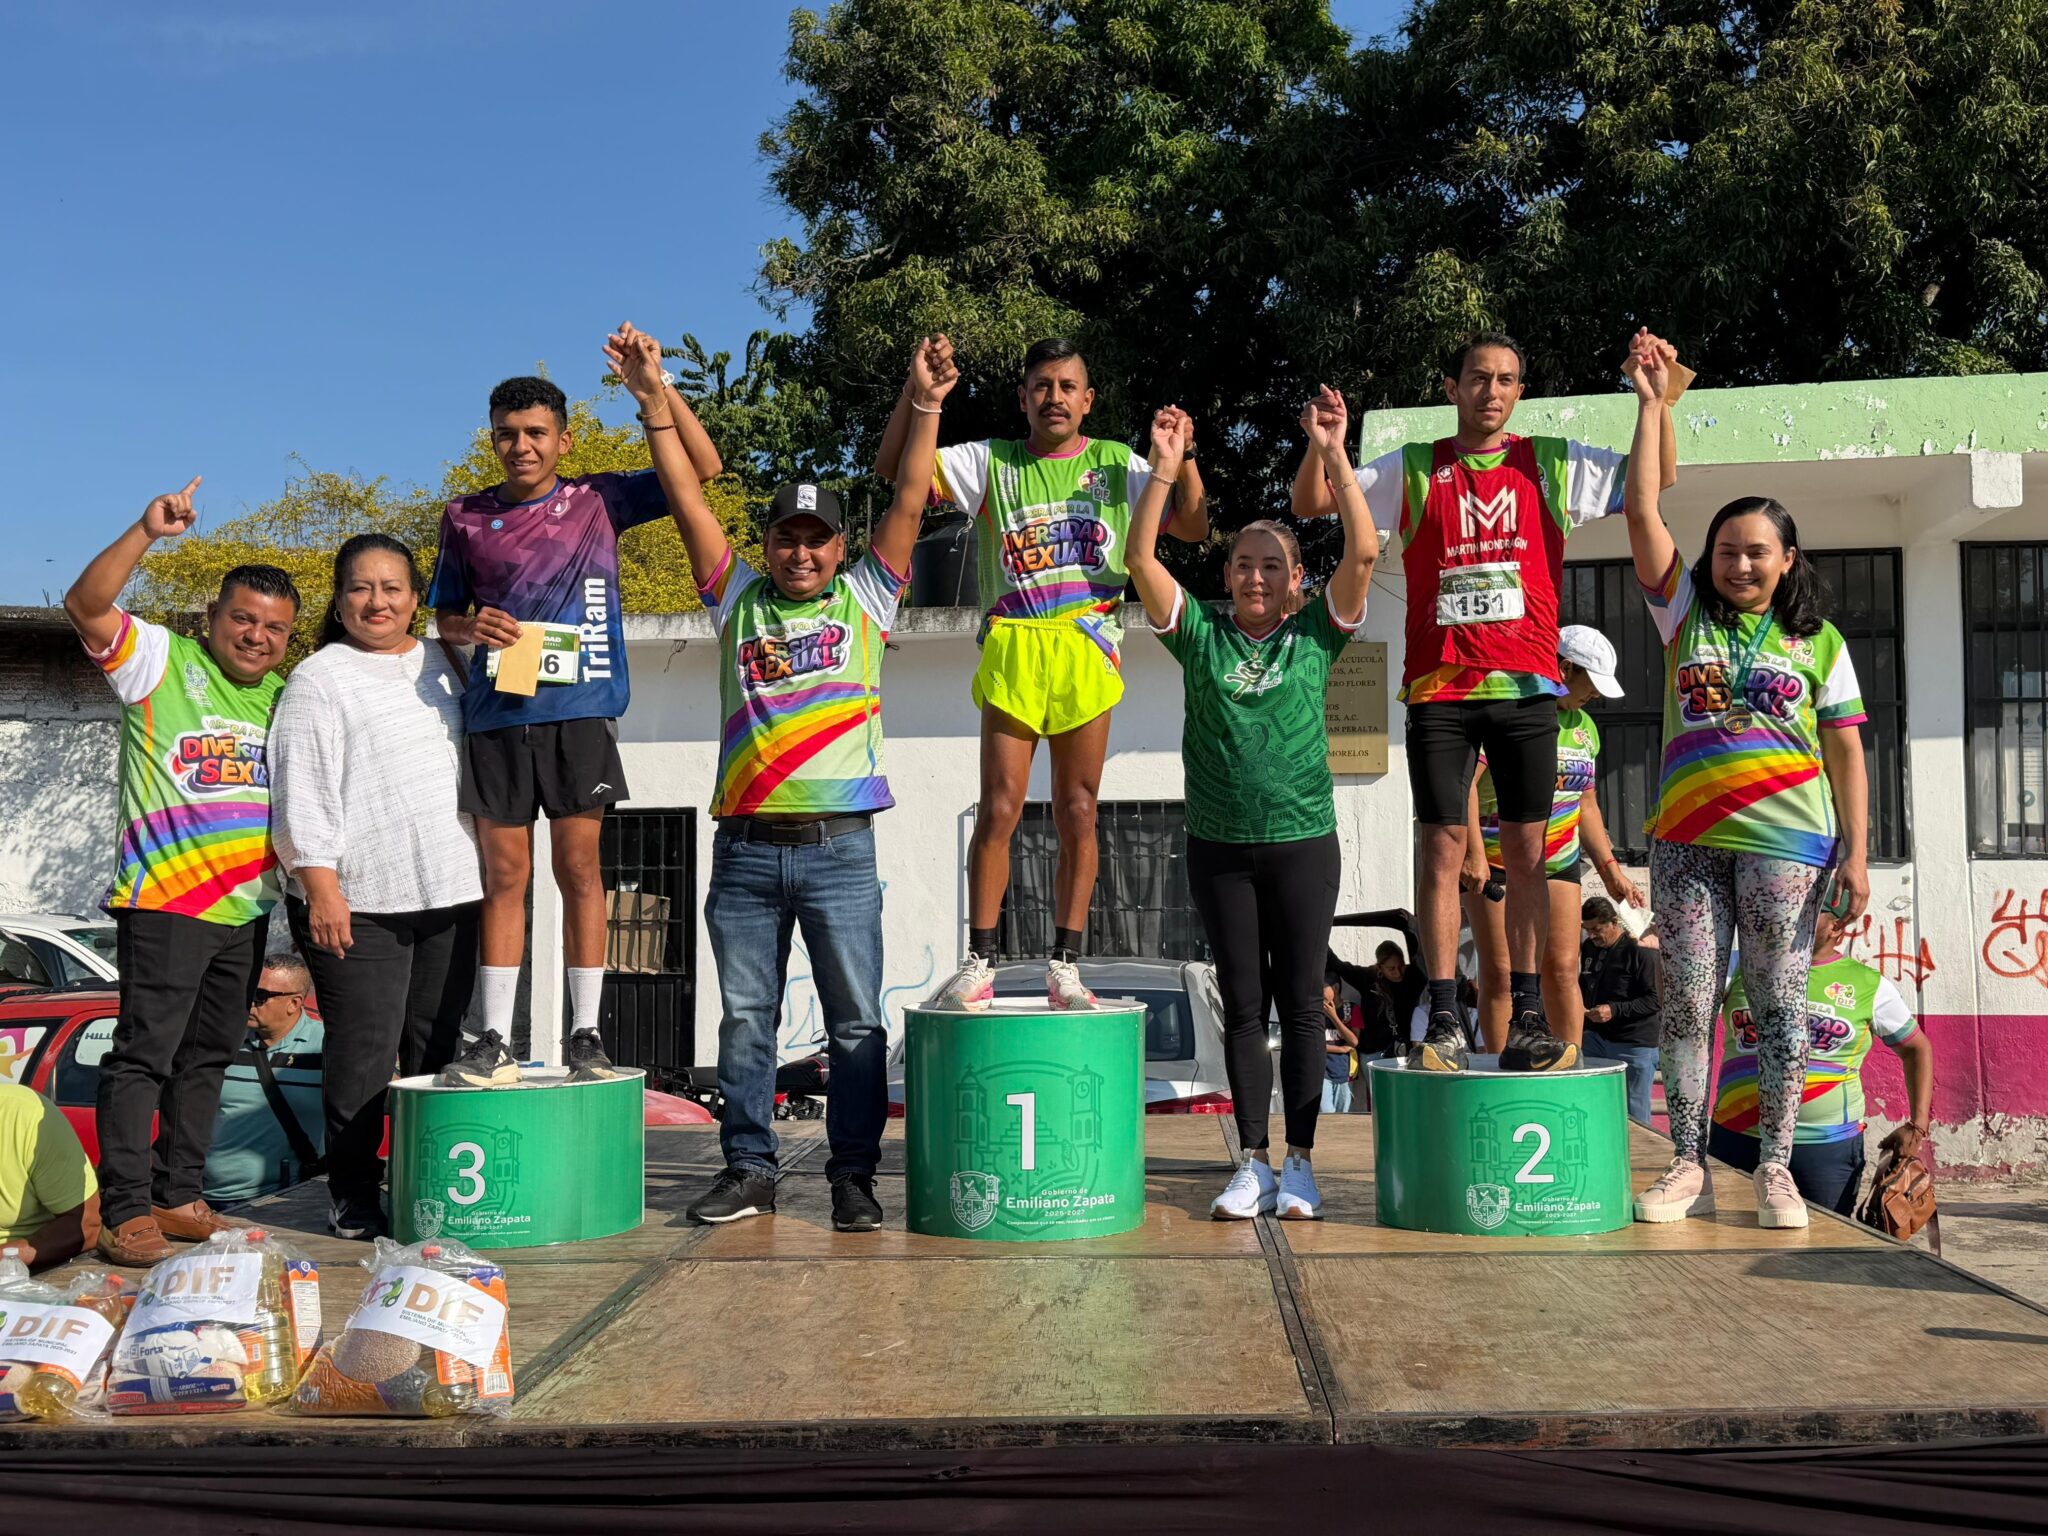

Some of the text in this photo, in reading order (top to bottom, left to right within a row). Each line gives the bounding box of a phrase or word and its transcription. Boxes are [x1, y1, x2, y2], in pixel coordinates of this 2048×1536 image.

[1053, 504, 1075, 515] POR
[1076, 503, 1090, 514] LA
[1446, 543, 1479, 557] MARTIN
[1456, 592, 1504, 616] 151
[579, 578, 612, 683] TriRam
[538, 654, 560, 675] 6
[749, 645, 838, 681] SEXUAL
[1793, 652, 1813, 665] DIF
[1679, 665, 1800, 697] DIVEIDAD
[1327, 749, 1369, 757] MORELOS
[200, 758, 268, 785] SEXU
[1006, 1091, 1036, 1170] 1
[1512, 1123, 1556, 1183] 2
[447, 1142, 486, 1205] 3
[1006, 1193, 1115, 1209] Emiliano Zapata
[1041, 1187, 1077, 1195] Gobierno
[1515, 1201, 1601, 1212] Emiliano Zapata
[448, 1214, 531, 1226] Emiliano Zapata
[161, 1266, 235, 1298] DIF
[404, 1282, 485, 1327] DIF
[8, 1315, 90, 1341] DIF
[399, 1314, 427, 1328] EMILIANO
[401, 1309, 426, 1321] SISTEMA
[426, 1317, 437, 1325] DIF
